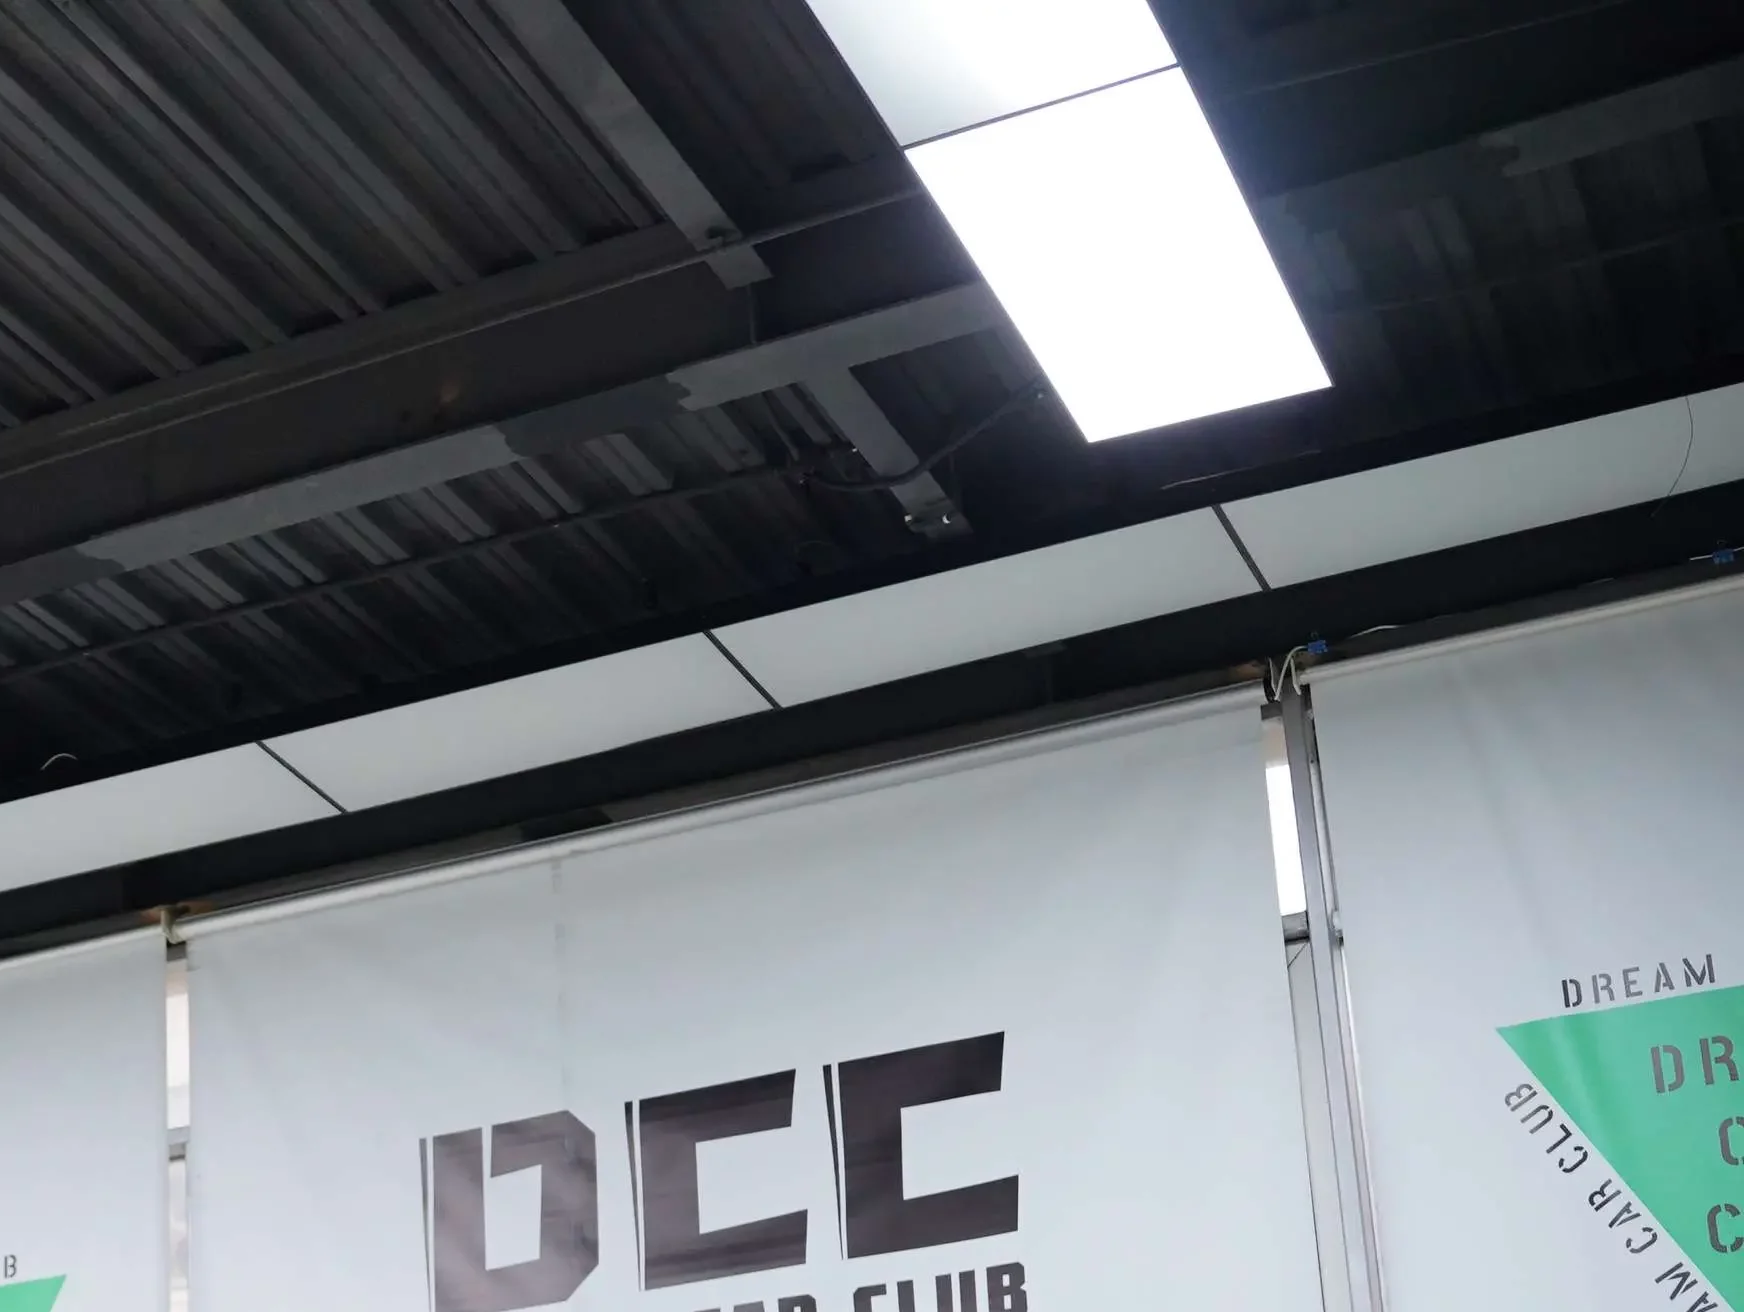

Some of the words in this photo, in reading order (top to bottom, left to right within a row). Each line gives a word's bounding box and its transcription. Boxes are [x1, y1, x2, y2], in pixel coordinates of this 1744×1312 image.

[1561, 953, 1716, 1009] DREAM
[1504, 1083, 1588, 1174] CLUB
[1588, 1178, 1658, 1254] CAR
